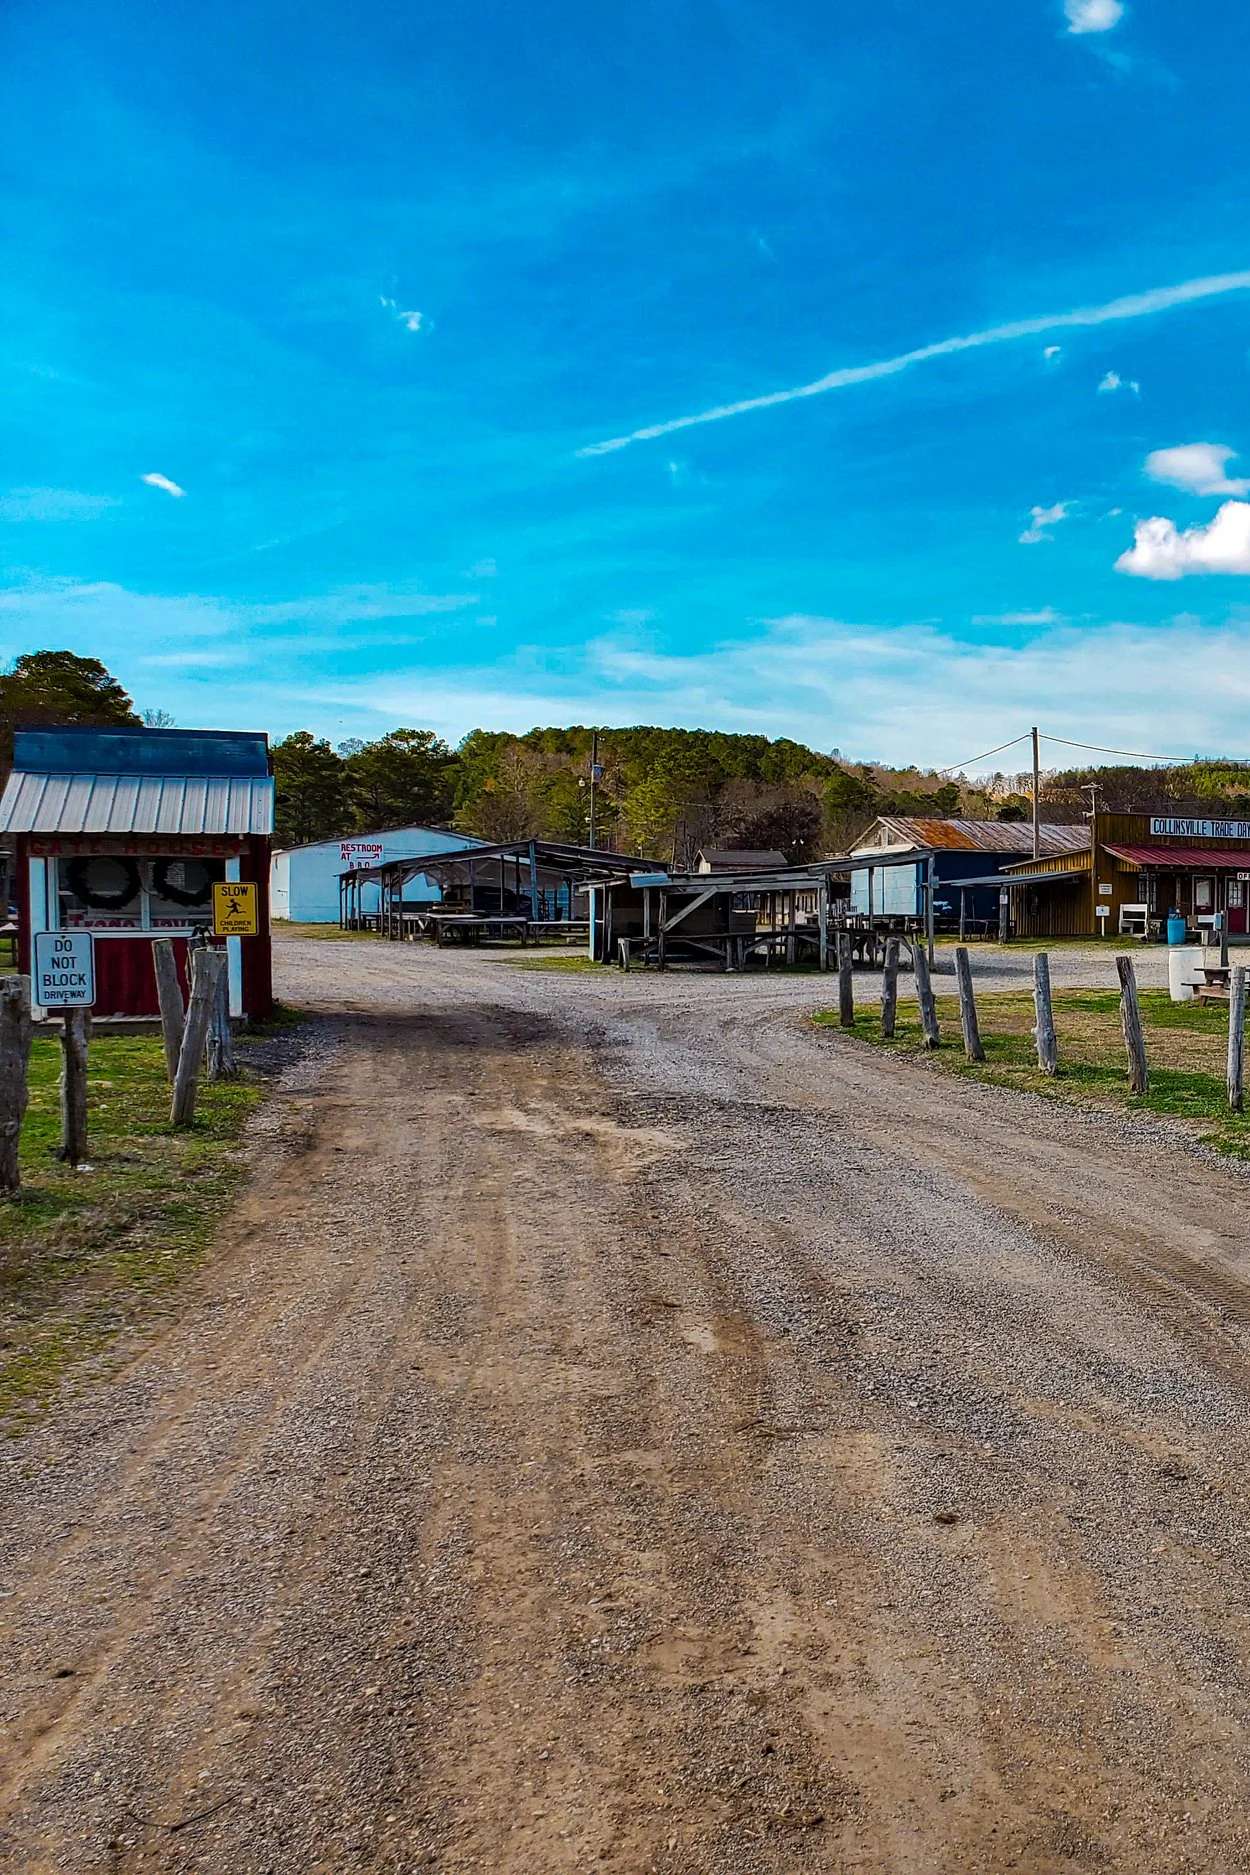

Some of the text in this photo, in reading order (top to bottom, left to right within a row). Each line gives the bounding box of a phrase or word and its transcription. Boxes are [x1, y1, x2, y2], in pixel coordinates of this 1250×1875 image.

[1153, 818, 1207, 836] COLLINSVILLE
[1210, 822, 1234, 837] TRADE
[341, 844, 382, 852] RESTROOM
[341, 852, 351, 860] AT
[221, 886, 248, 897] SLOW
[54, 939, 73, 953] DO
[51, 956, 77, 969] NOT
[43, 973, 87, 986] BLOCK
[43, 990, 86, 999] DRIVEWAY
